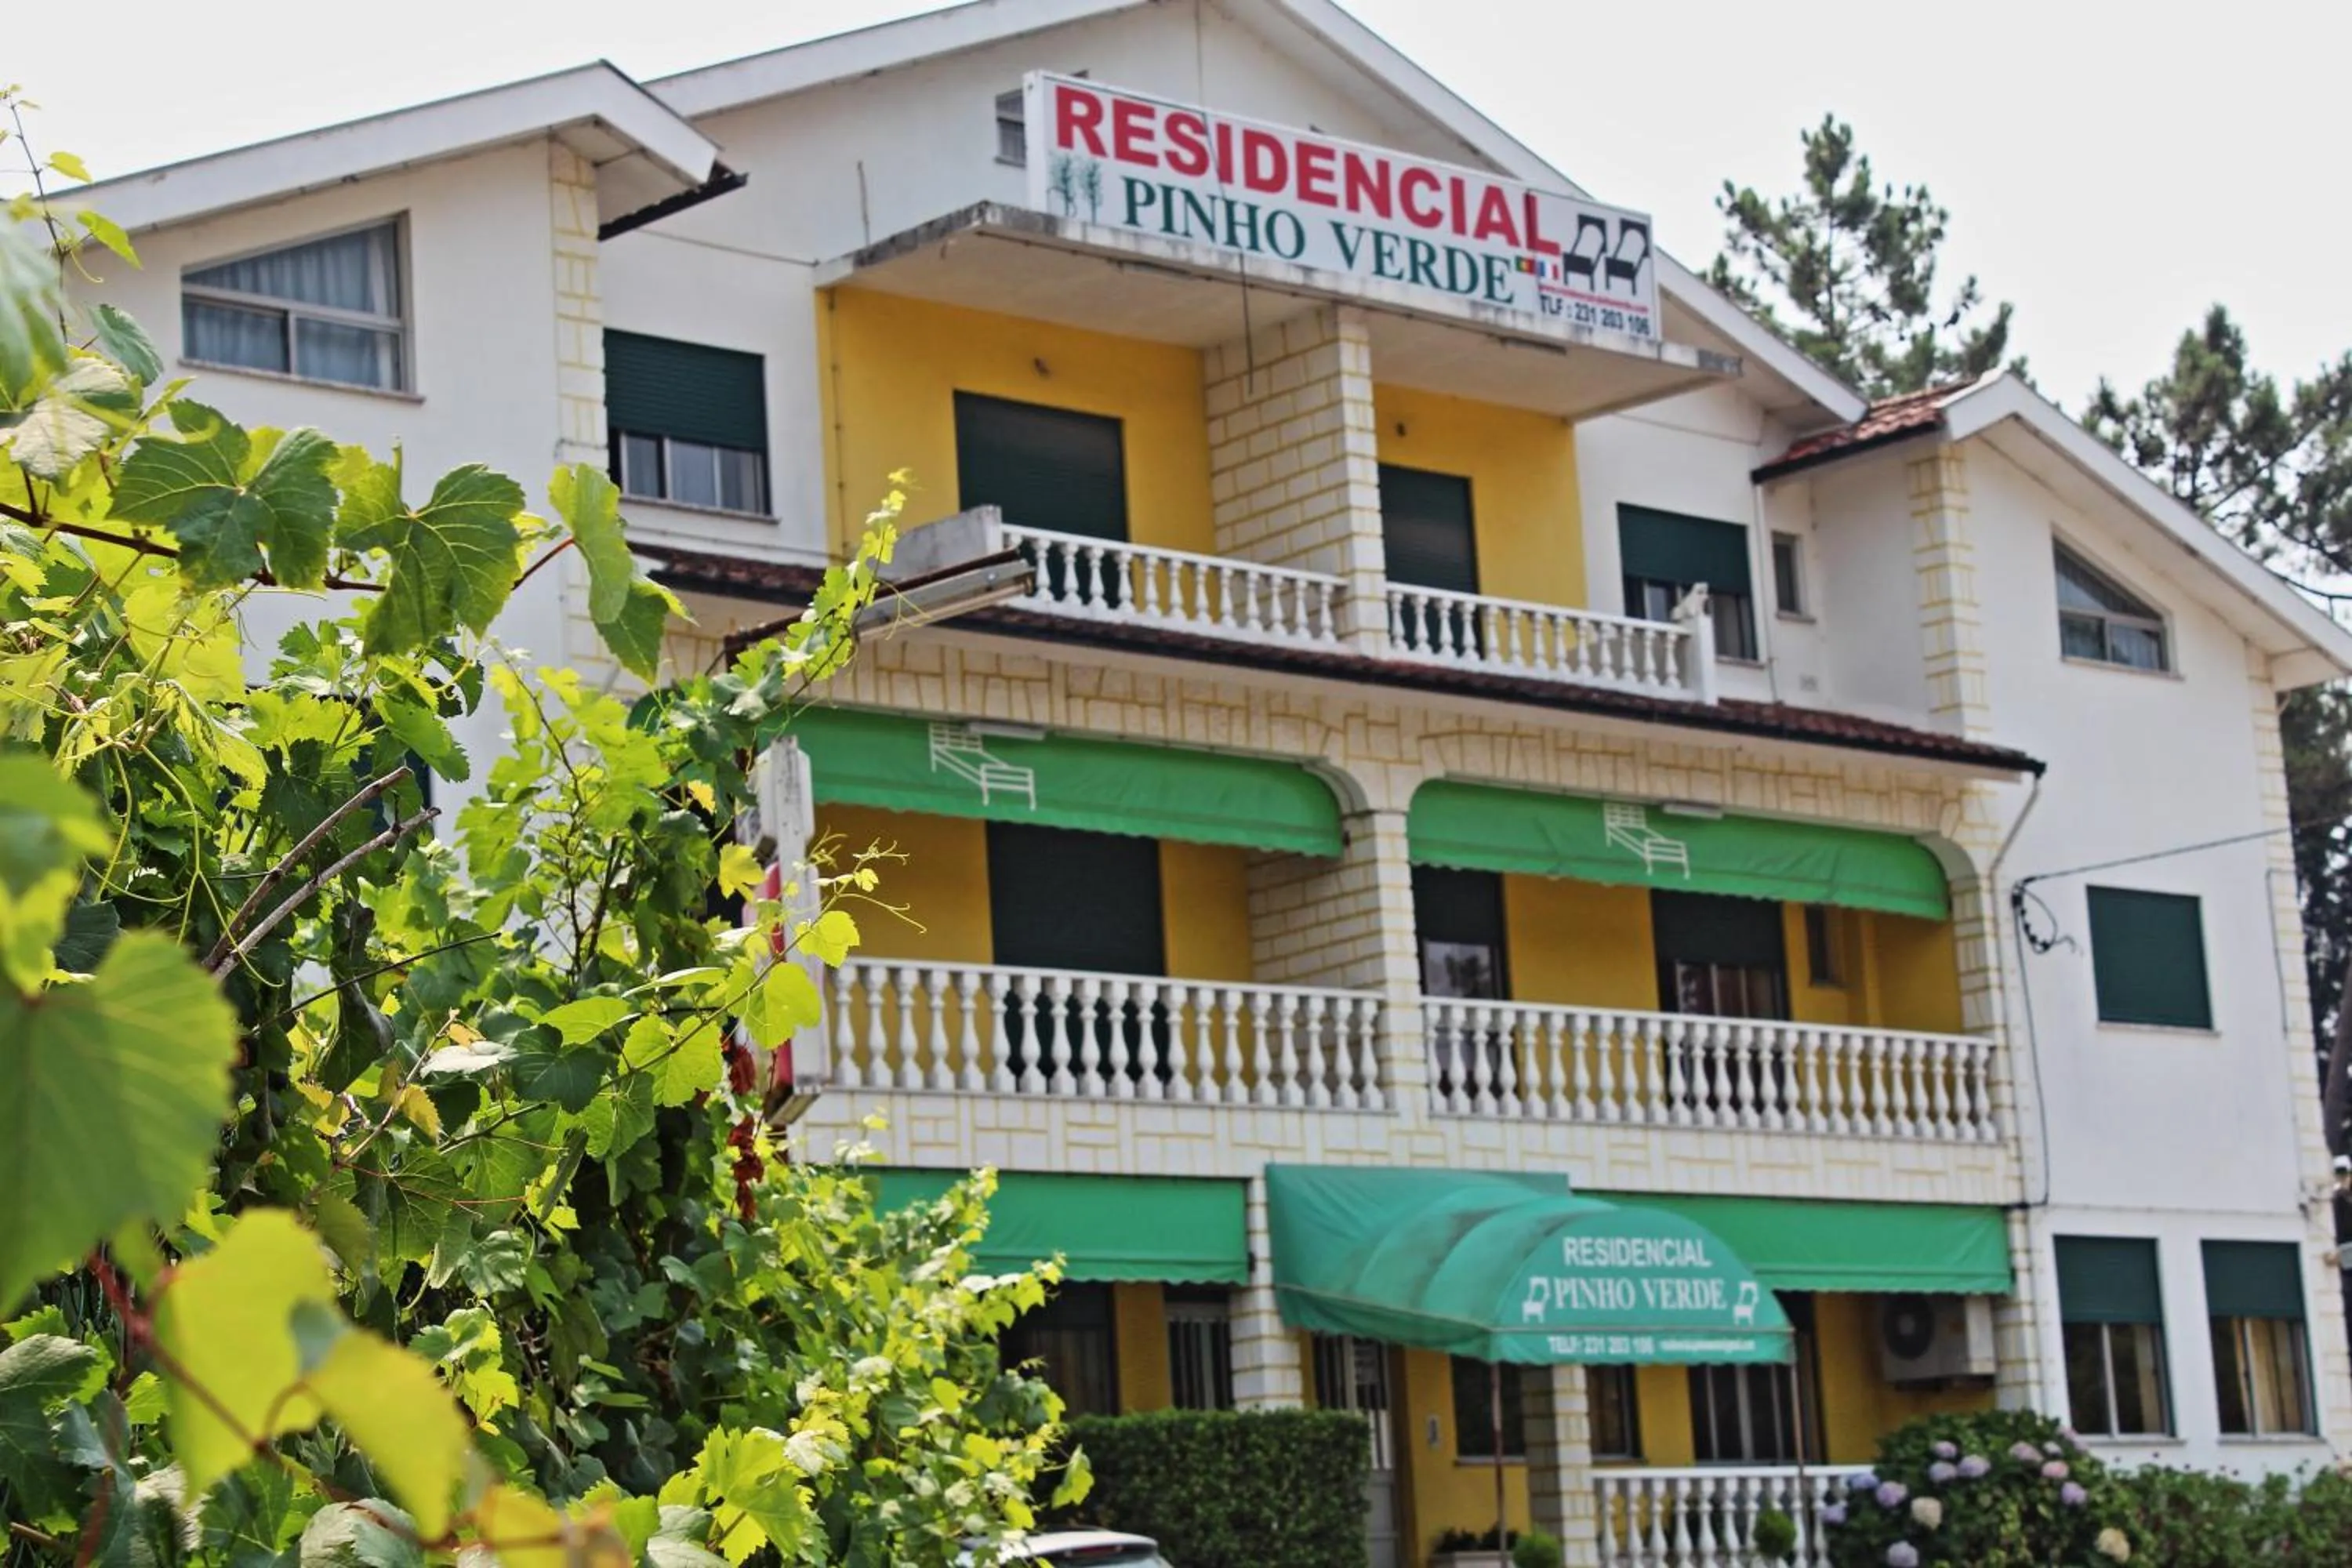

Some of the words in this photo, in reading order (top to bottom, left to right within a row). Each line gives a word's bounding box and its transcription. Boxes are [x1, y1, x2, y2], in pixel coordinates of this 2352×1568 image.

[1055, 85, 1561, 256] RESIDENCIAL
[1121, 175, 1306, 260] PINHO
[1328, 220, 1515, 305] VERDE
[1554, 1276, 1635, 1309] PINHO
[1641, 1278, 1727, 1310] VERDE
[1564, 1236, 1712, 1268] RESIDENCIAL
